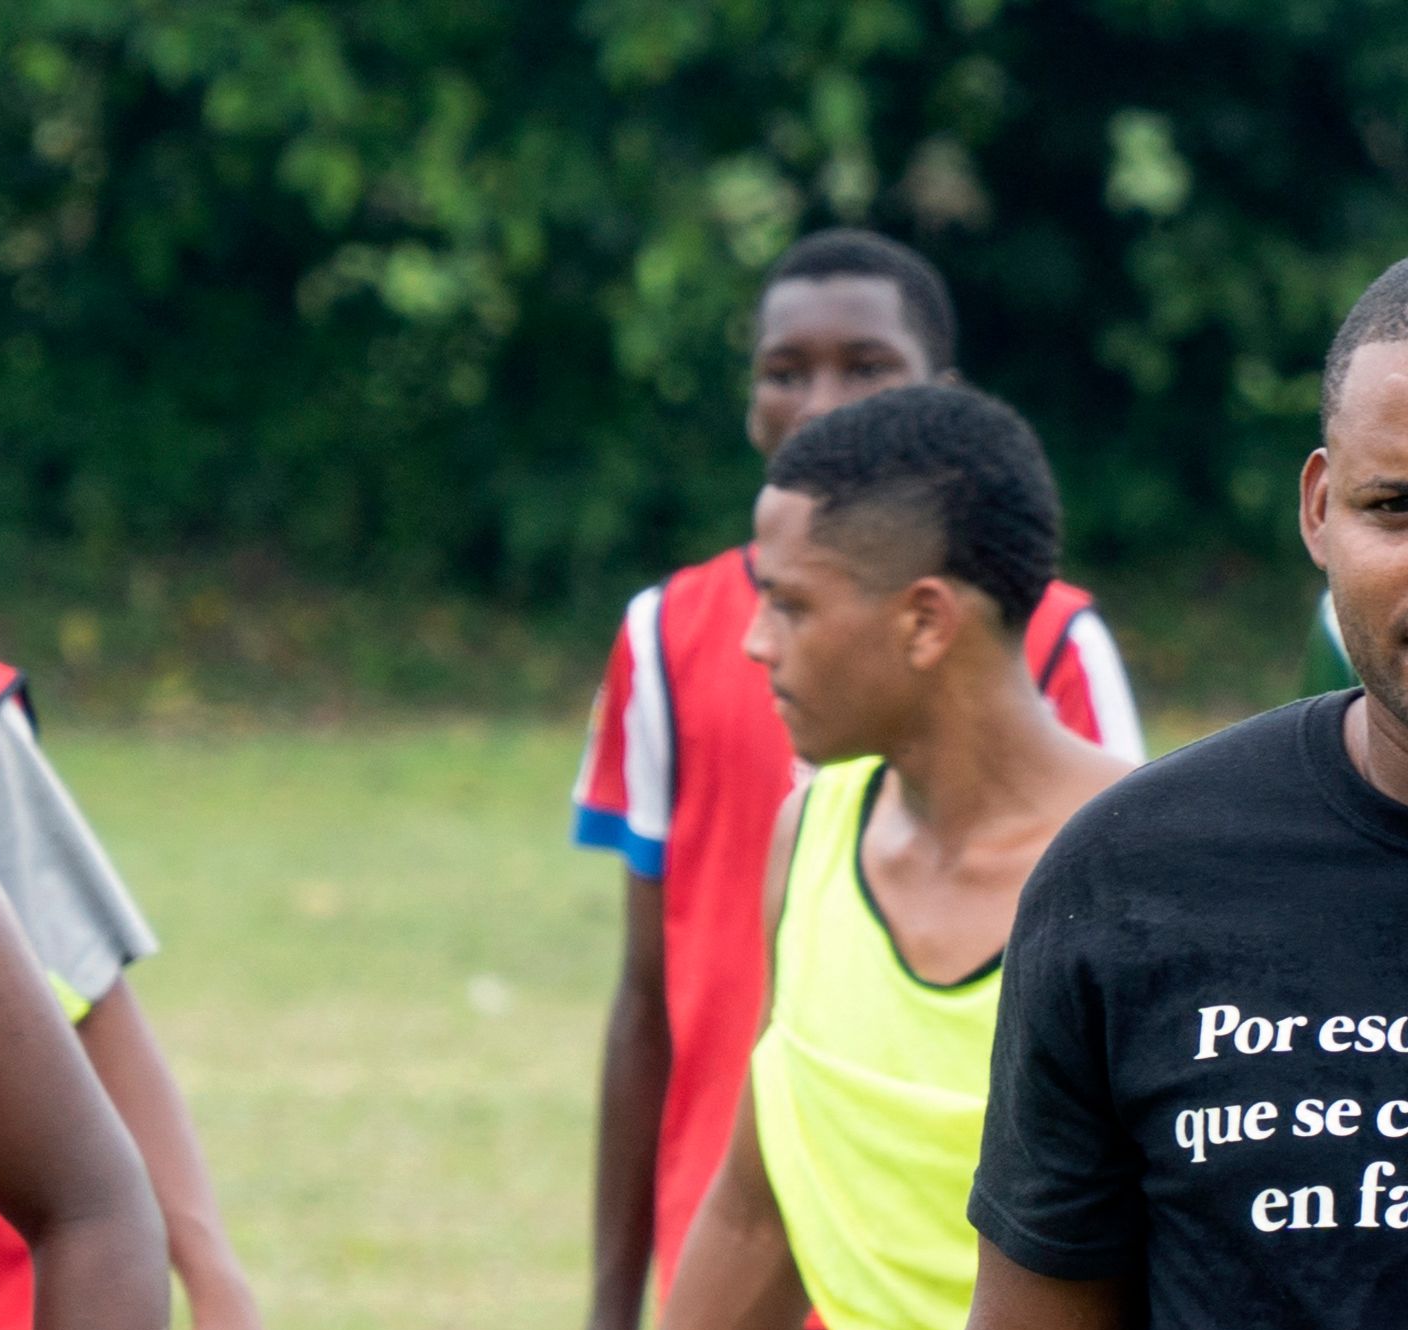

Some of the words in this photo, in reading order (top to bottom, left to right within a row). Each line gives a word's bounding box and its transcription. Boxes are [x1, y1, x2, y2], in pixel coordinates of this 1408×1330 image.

[1193, 1004, 1309, 1060] Por
[1175, 1101, 1278, 1162] que
[1291, 1098, 1362, 1138] se
[1251, 1185, 1339, 1233] en
